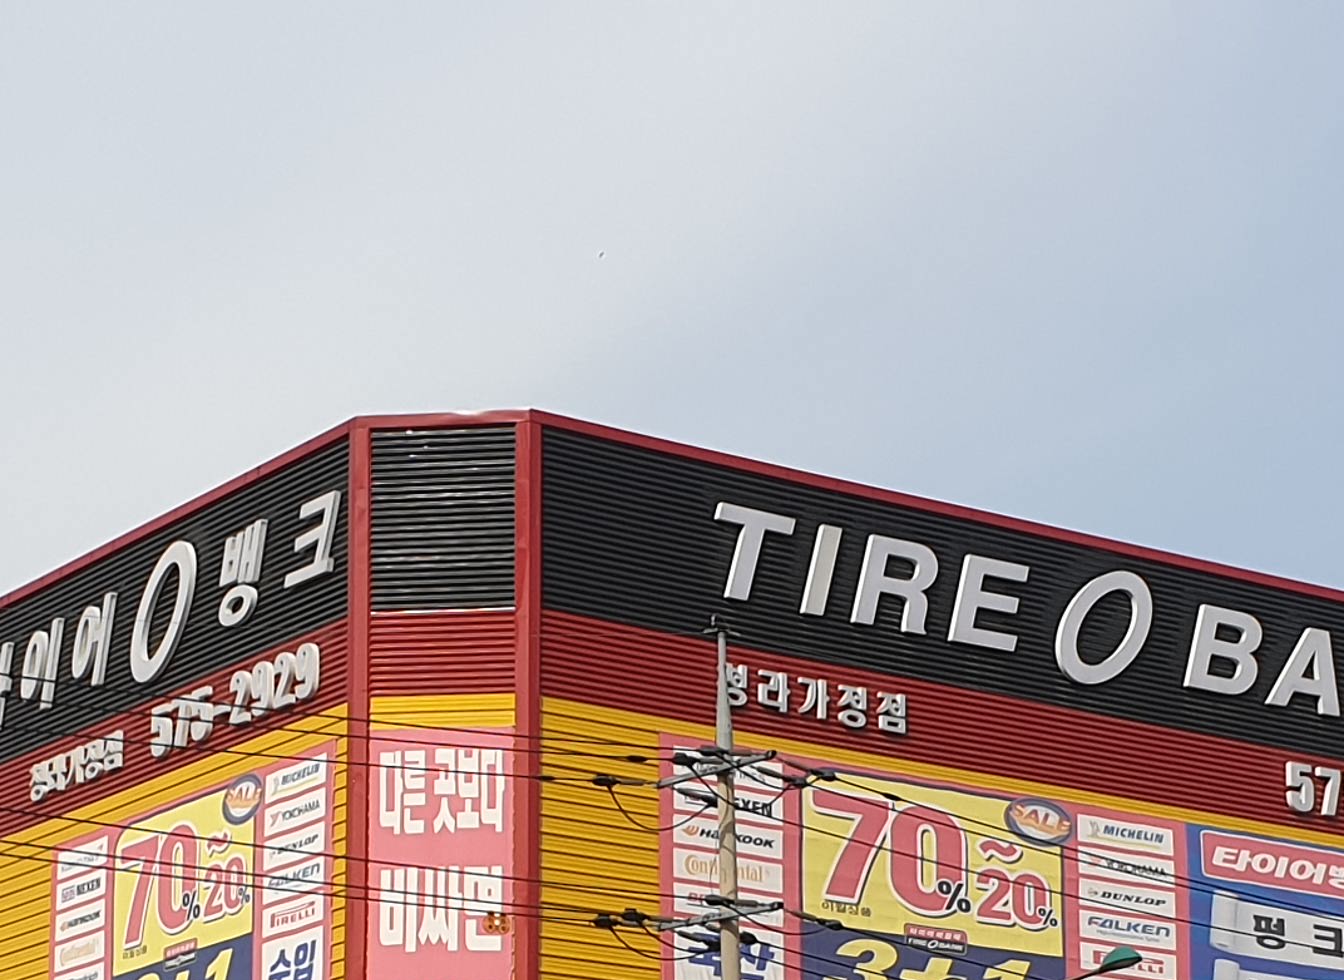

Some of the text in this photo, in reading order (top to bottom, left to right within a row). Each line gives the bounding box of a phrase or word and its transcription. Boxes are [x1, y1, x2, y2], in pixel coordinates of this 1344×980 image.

[218, 490, 340, 628] 뱅크
[713, 502, 1029, 652] TIRE
[150, 642, 320, 757] 575-2929
[379, 746, 505, 835] 다른 곳보다
[1103, 825, 1164, 844] MICHELIN
[270, 900, 316, 928] PIRELLI
[380, 866, 503, 953] 비싸면
[1088, 916, 1170, 938] FALKEN
[1100, 891, 1166, 906] DUNLOP
